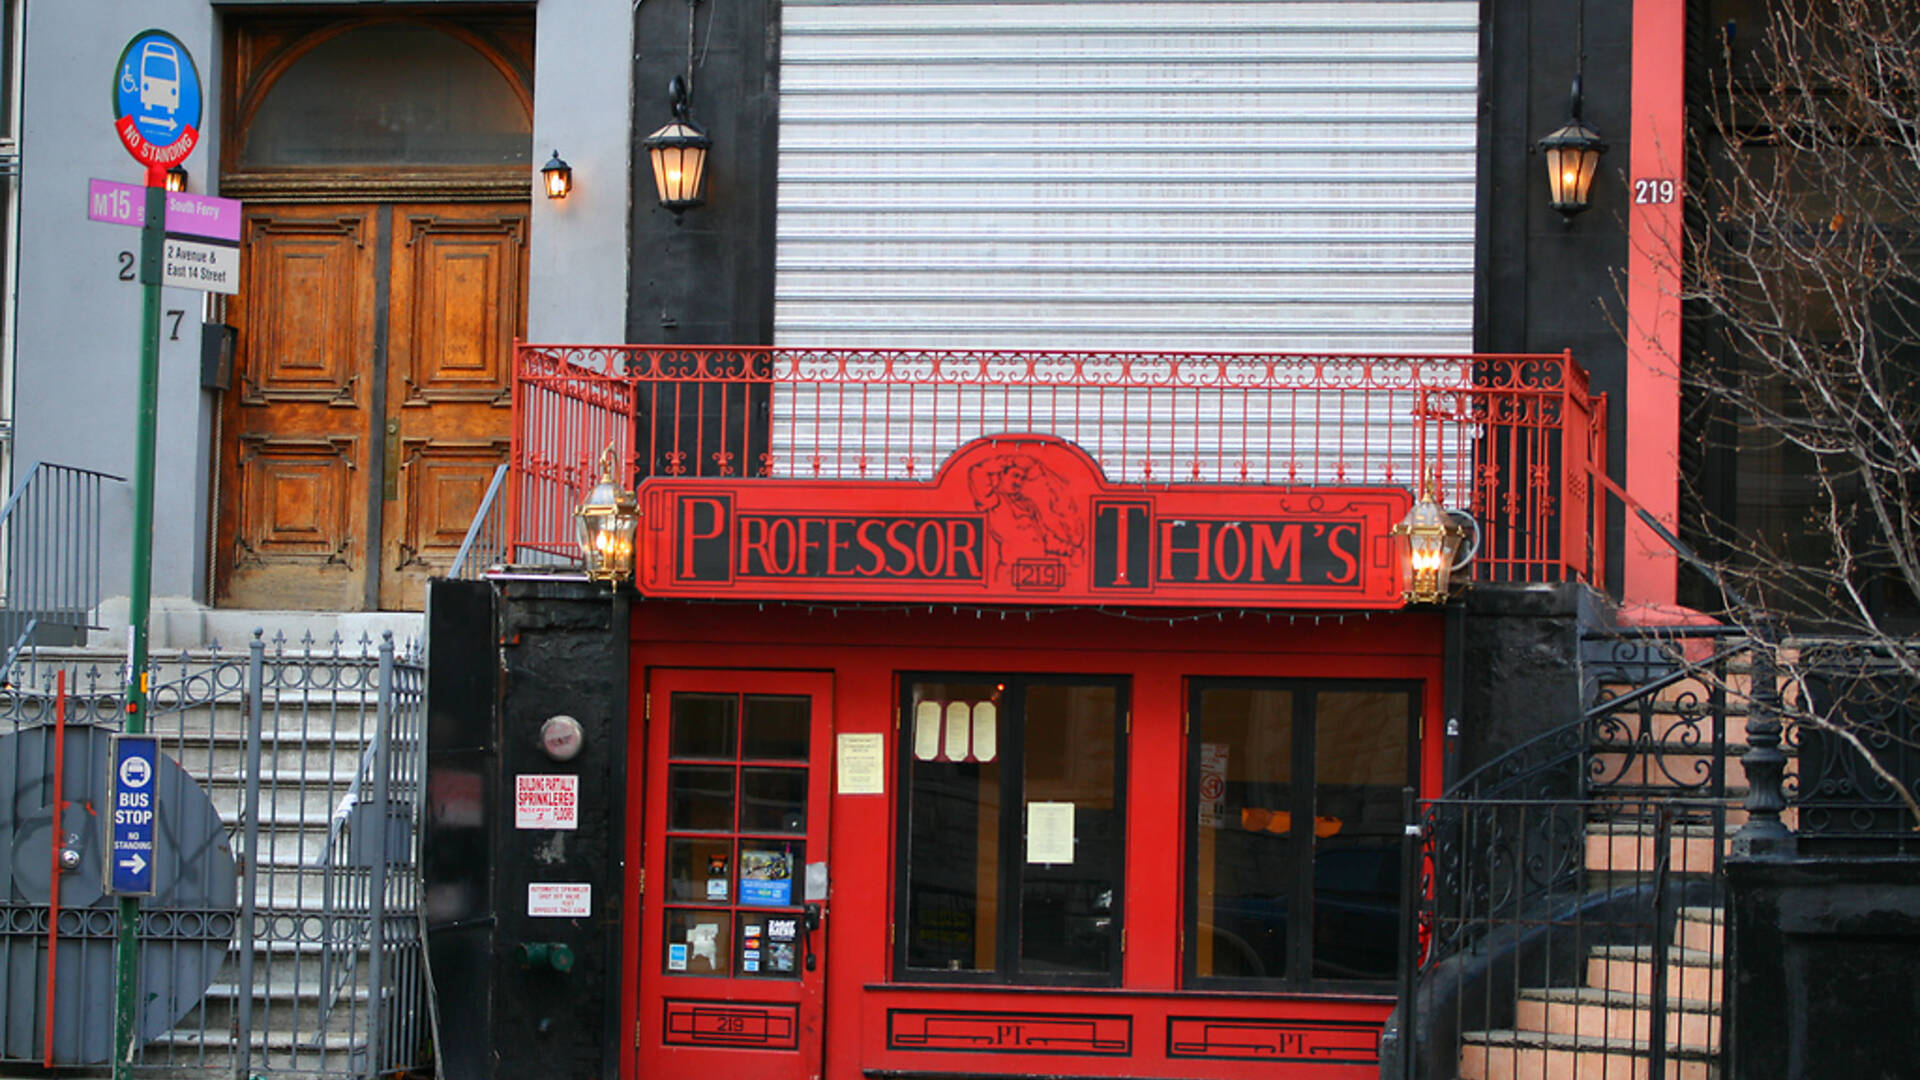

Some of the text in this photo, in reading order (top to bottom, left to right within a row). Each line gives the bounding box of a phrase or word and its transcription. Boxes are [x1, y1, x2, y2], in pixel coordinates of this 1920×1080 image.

[123, 124, 193, 163] NO STANDING
[1635, 180, 1674, 204] 219
[93, 189, 131, 219] M15
[170, 197, 220, 221] South Ferry
[168, 246, 217, 264] 2 Avenue &
[118, 251, 136, 281] 2
[167, 263, 227, 282] East 14 Street
[167, 310, 185, 340] 7
[679, 498, 1358, 584] PROFESSOR THOM'S
[1021, 564, 1057, 585] 219
[119, 792, 149, 807] BUS
[519, 792, 575, 806] SPRINKLERED
[115, 810, 152, 825] STOP
[114, 841, 152, 850] STANDING
[127, 831, 140, 840] NO
[717, 1016, 744, 1032] 219
[995, 1025, 1026, 1045] PT
[1279, 1033, 1309, 1054] PT
